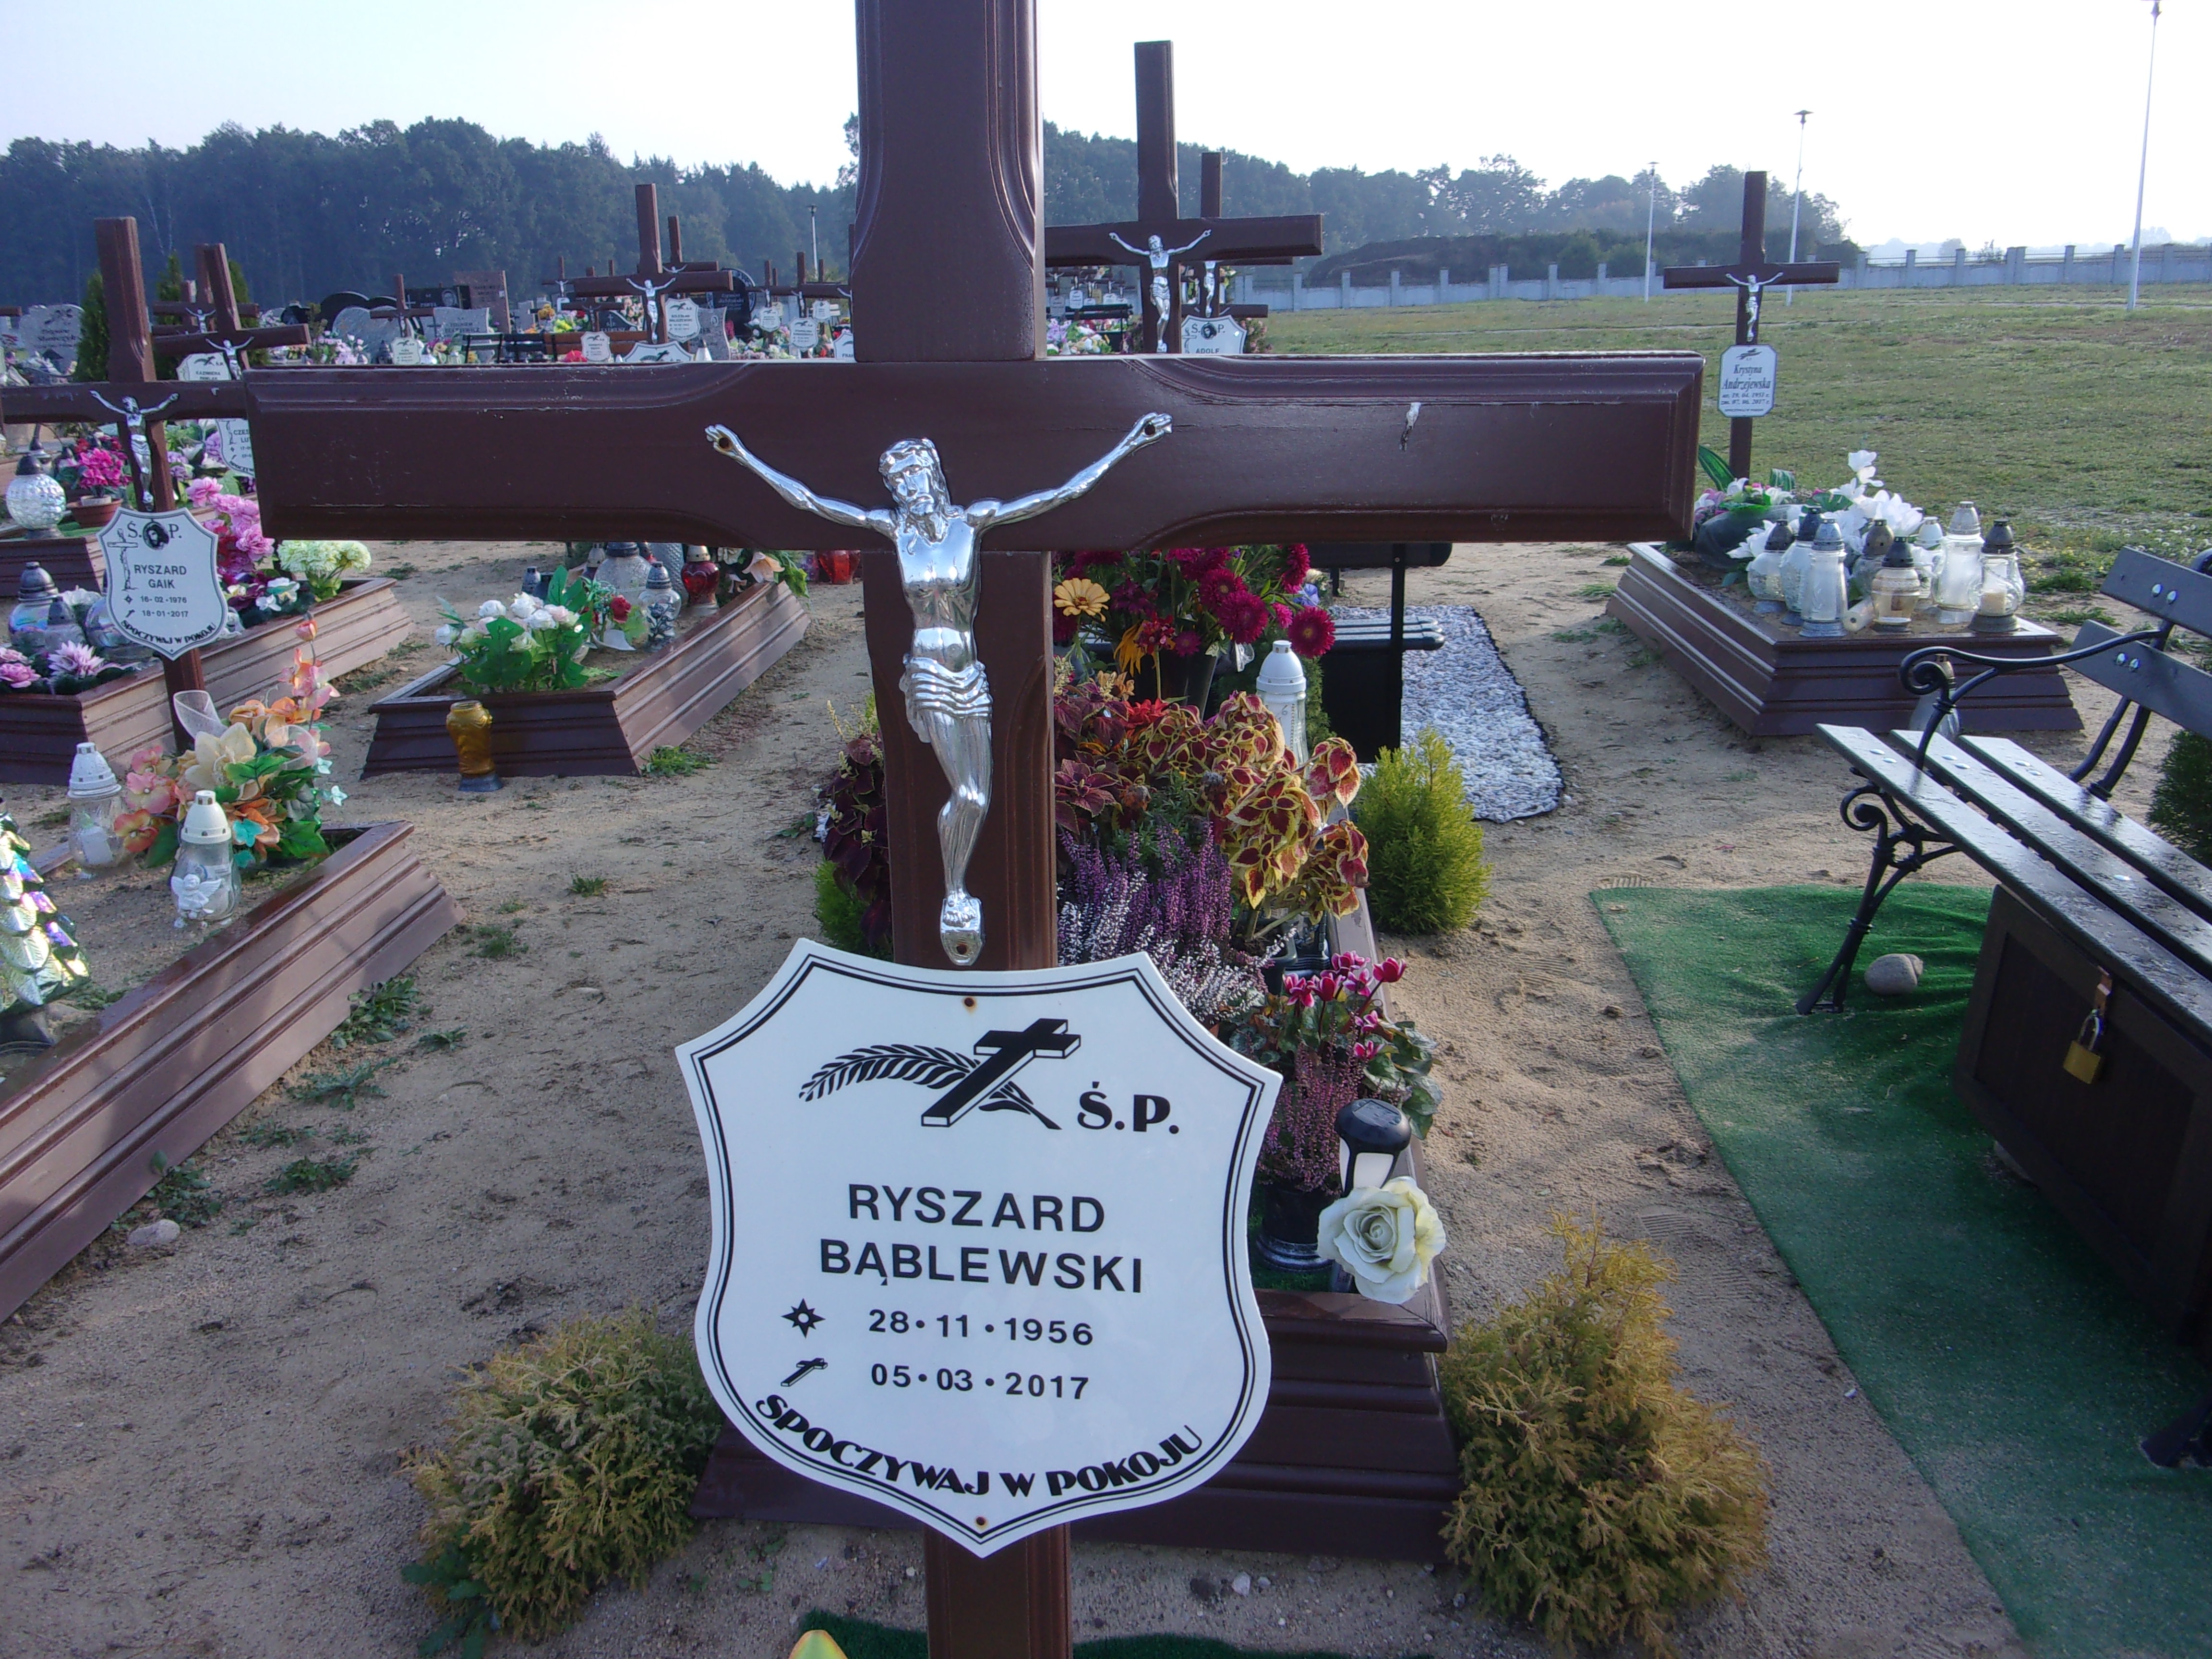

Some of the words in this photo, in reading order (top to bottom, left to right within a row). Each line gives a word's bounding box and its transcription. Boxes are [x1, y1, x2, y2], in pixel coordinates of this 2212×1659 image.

[1733, 364, 1763, 376] Krystyna
[1722, 377, 1771, 392] Andrzejewska
[133, 564, 187, 575] RYSZARD
[148, 578, 176, 589] GAIK
[121, 619, 173, 644] SPOCZYWAJ
[184, 622, 216, 643] POKOJU
[1076, 1080, 1180, 1135] Ś.P.
[849, 1183, 1105, 1233] RYSZARD
[820, 1238, 1142, 1293] BĄBLEWSKI
[755, 1394, 989, 1496] SPOCZYWAJ
[998, 1472, 1035, 1498] W
[1045, 1424, 1202, 1497] POKOJU
